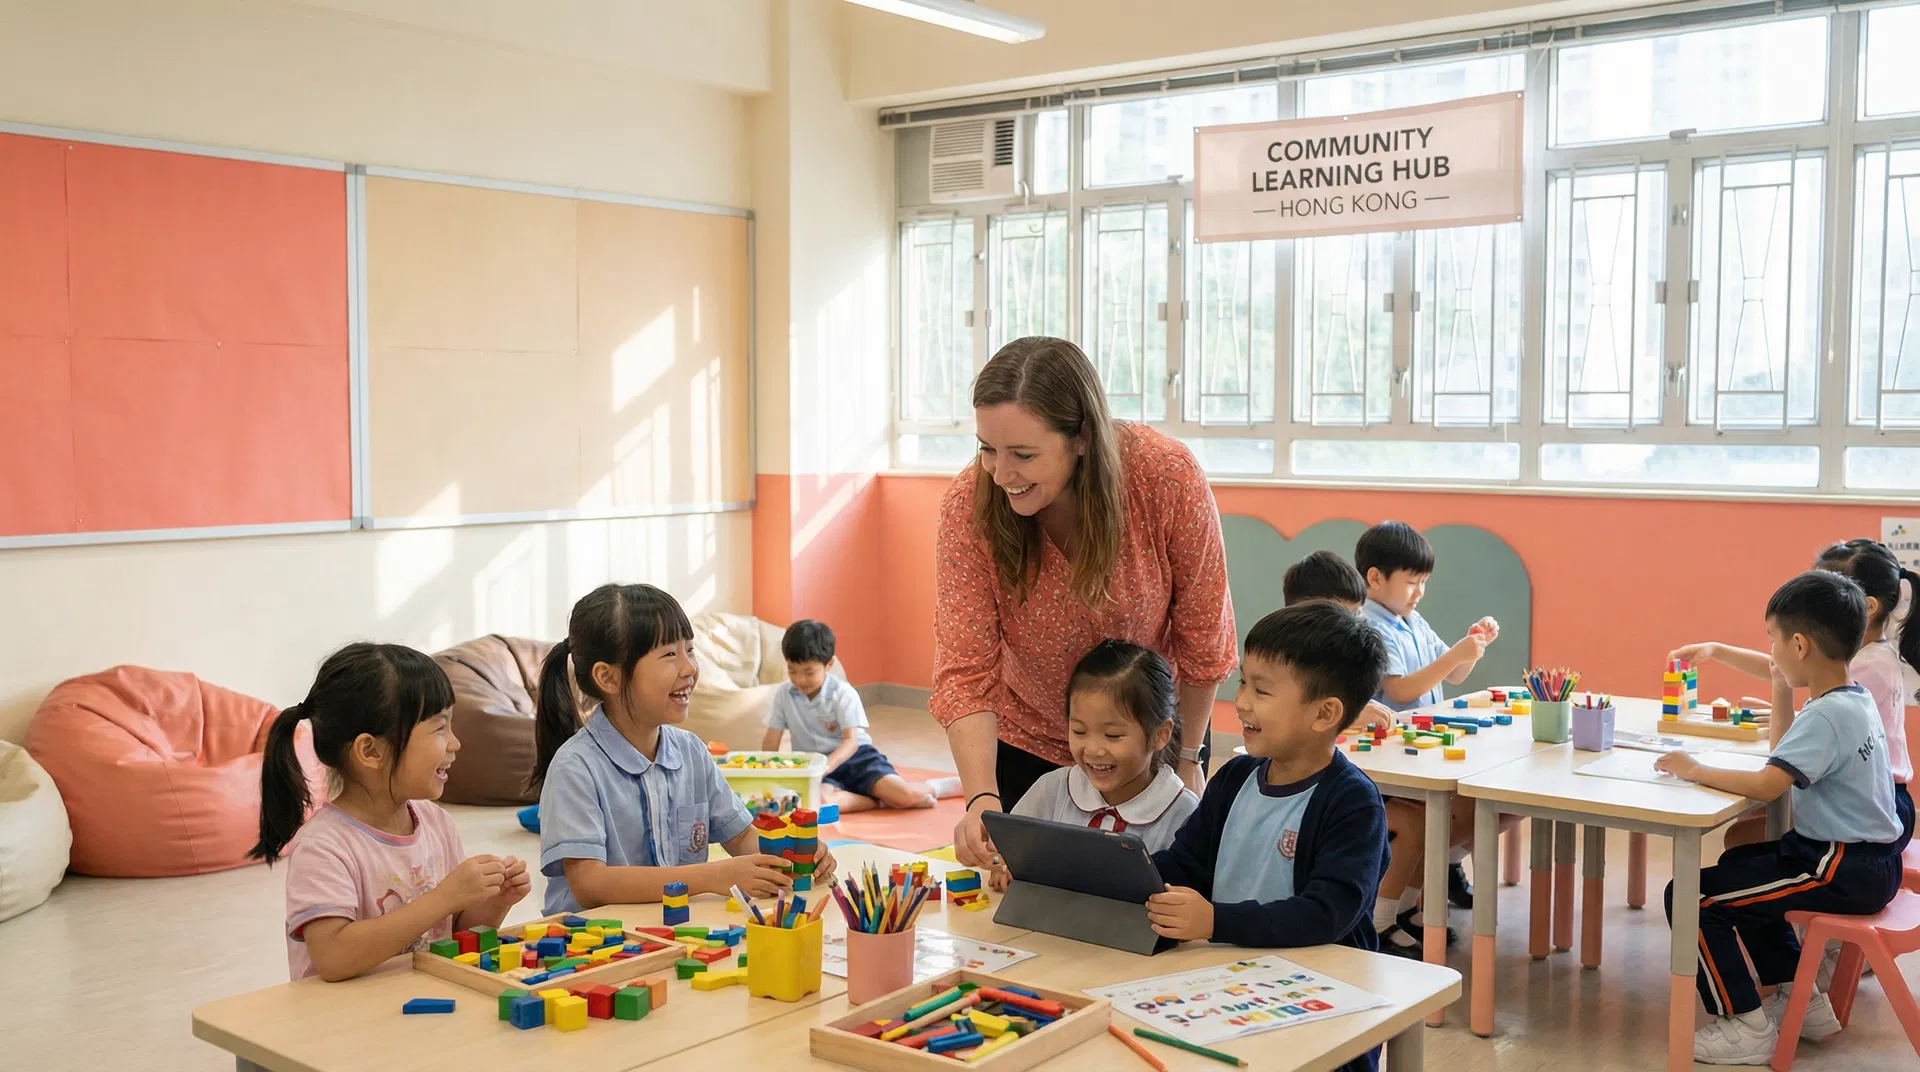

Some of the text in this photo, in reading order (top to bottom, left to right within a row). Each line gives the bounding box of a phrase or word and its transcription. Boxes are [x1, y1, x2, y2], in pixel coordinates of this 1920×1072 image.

[1267, 127, 1433, 162] COMMUNITY
[1253, 156, 1450, 193] LEARNING HUB
[1280, 190, 1417, 218] HONG KONG
